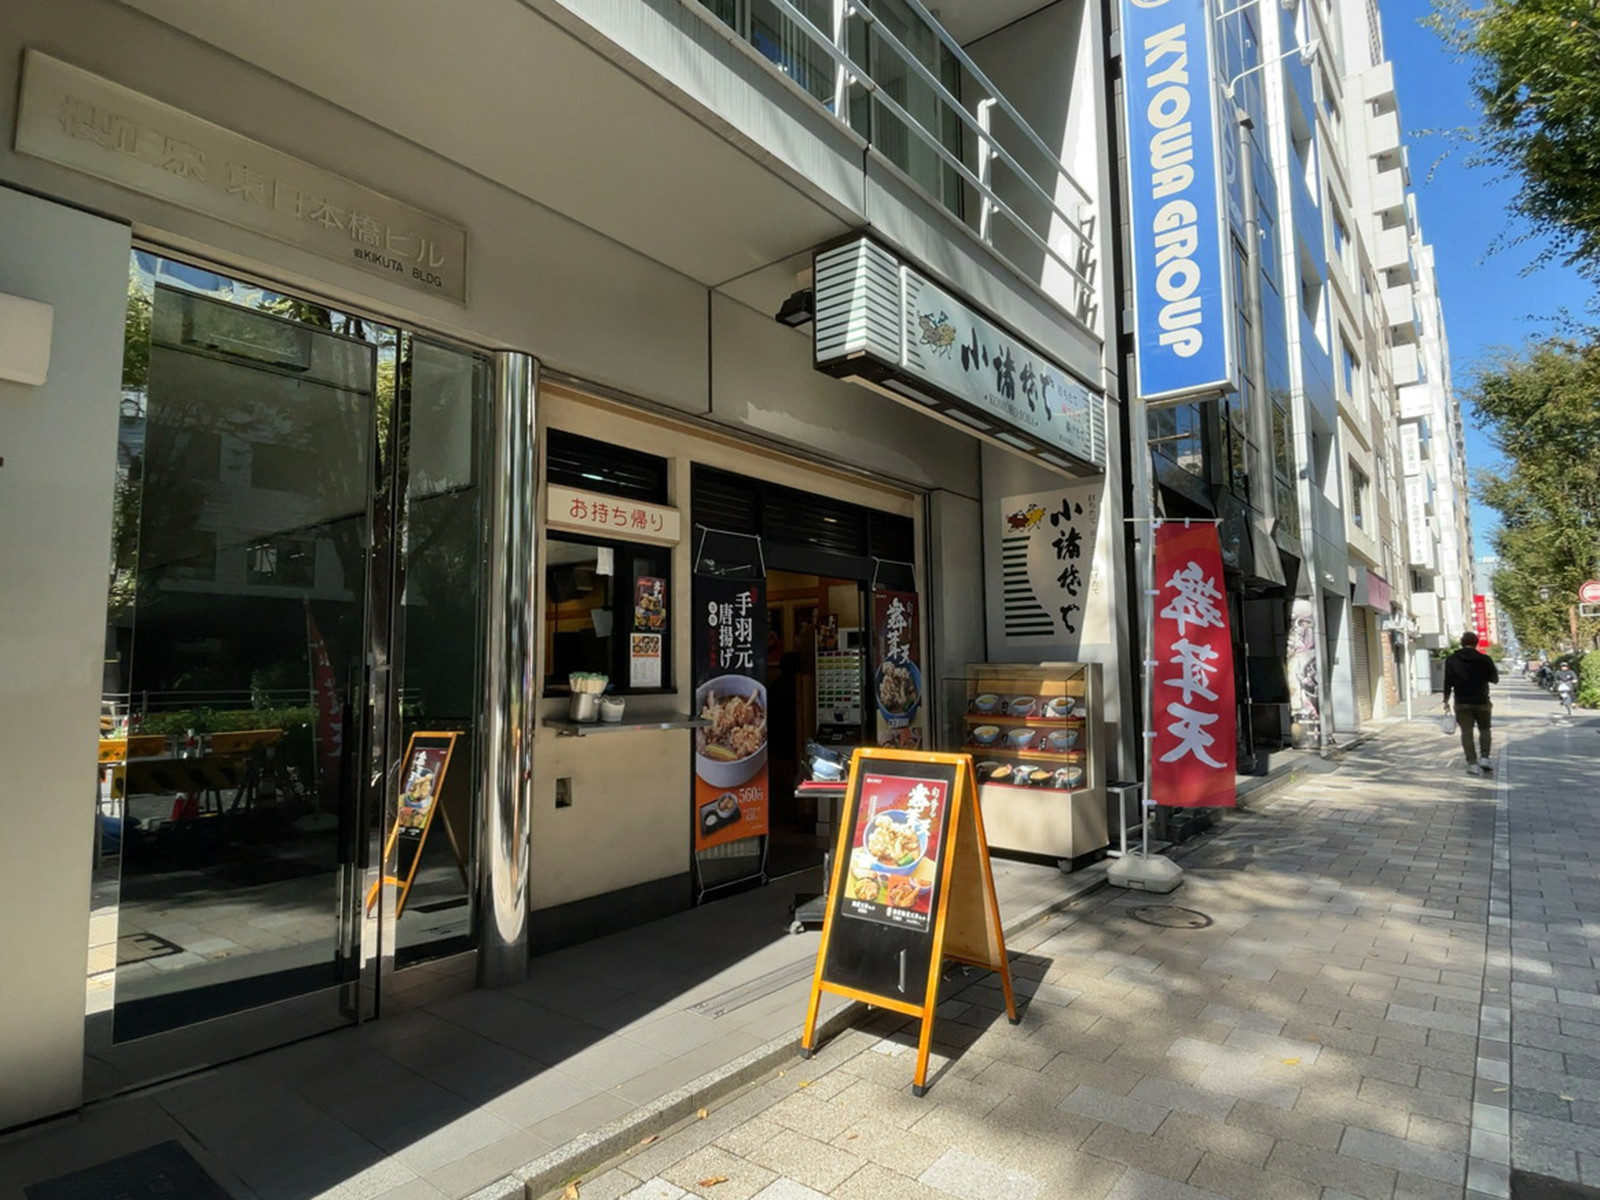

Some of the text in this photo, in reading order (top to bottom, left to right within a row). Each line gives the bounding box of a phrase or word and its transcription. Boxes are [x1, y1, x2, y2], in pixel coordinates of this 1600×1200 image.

[226, 160, 446, 268] 東日本橋ビル
[1144, 22, 1204, 359] KYOWA GROUP
[411, 266, 443, 287] BLDG
[569, 497, 664, 532] お持ち帰り
[718, 602, 735, 670] 唐揚げ
[735, 590, 754, 670] 手羽元
[1158, 560, 1228, 769] 舞茸天
